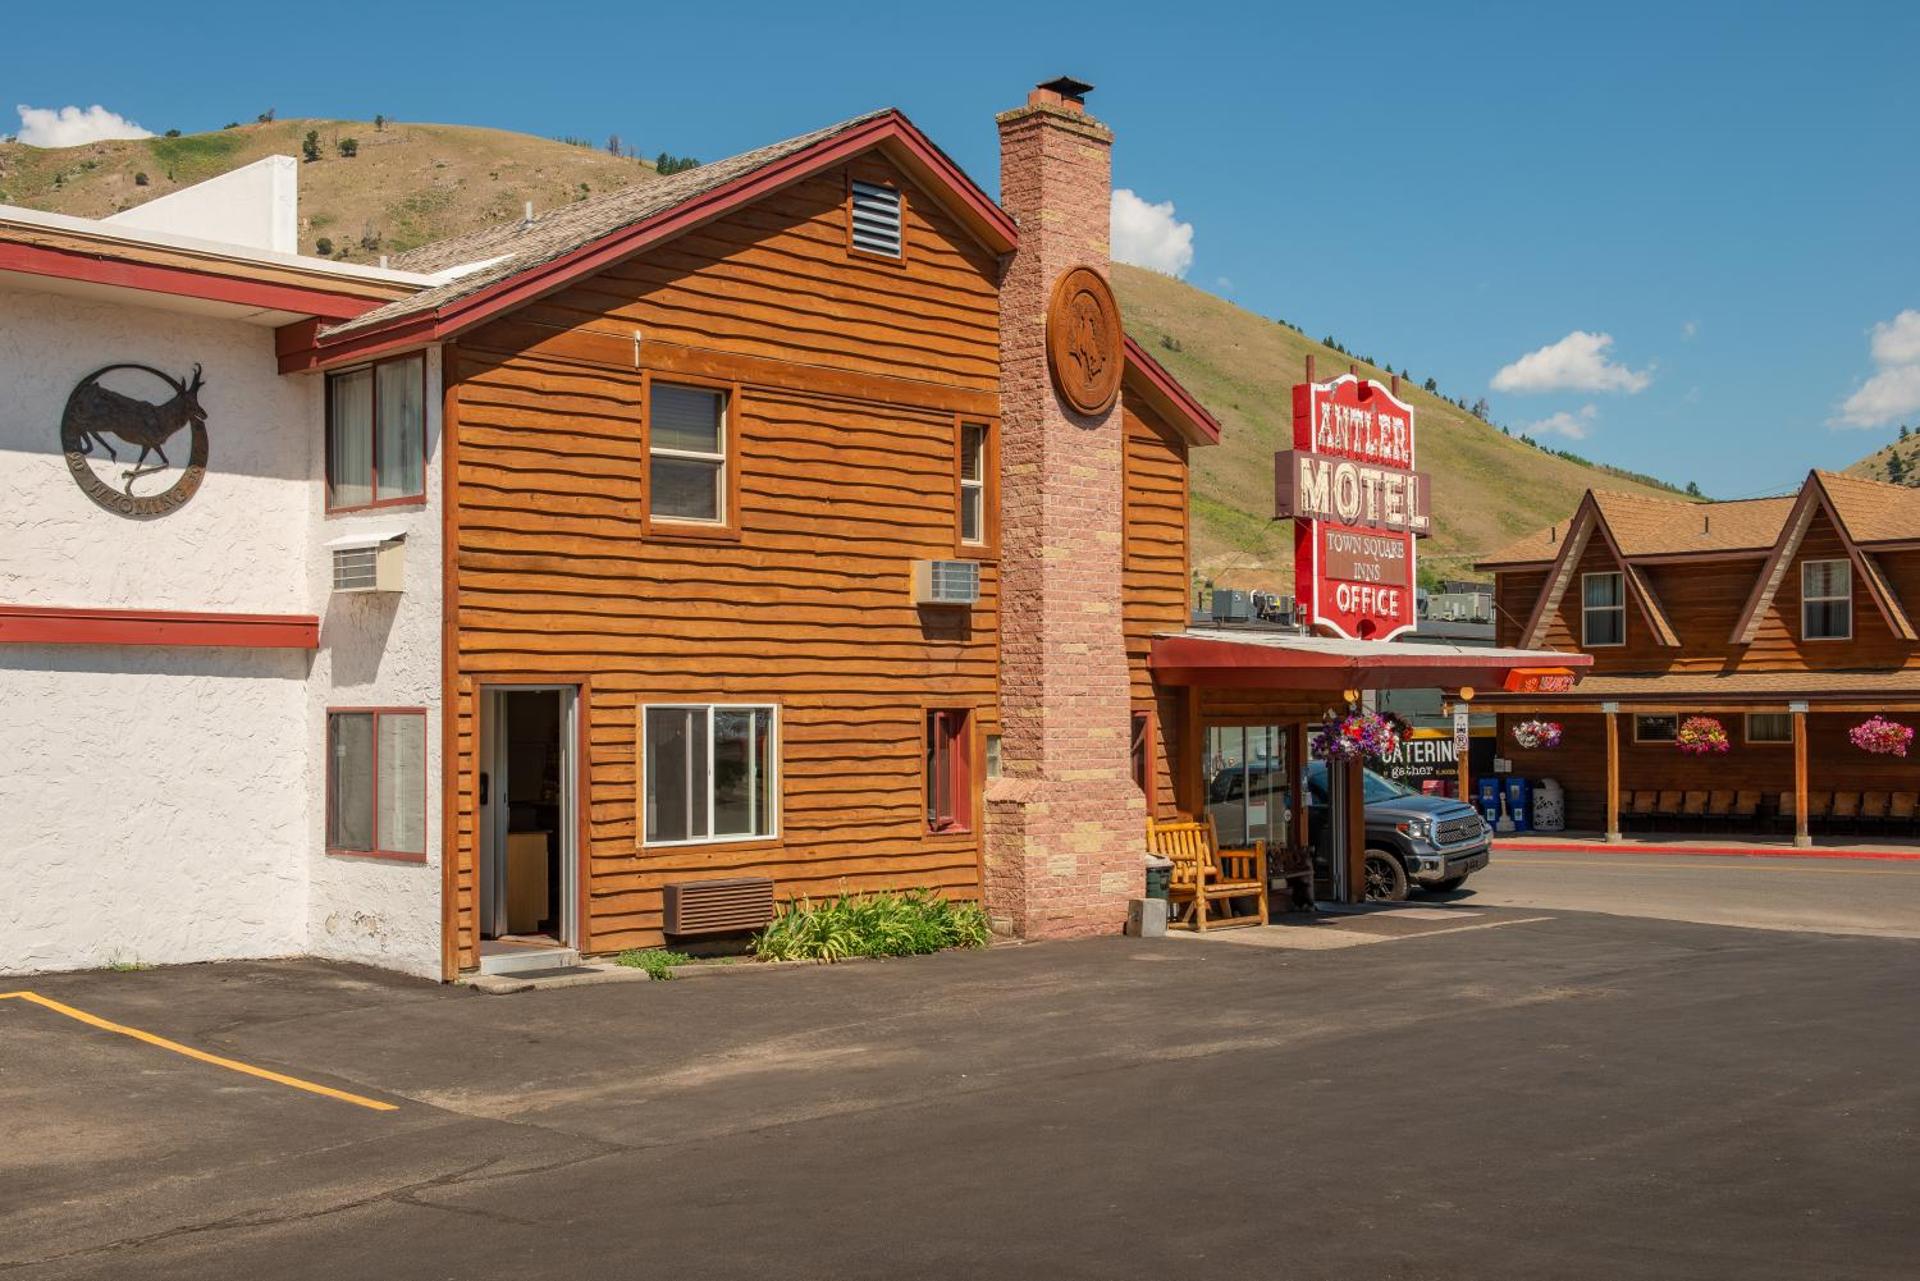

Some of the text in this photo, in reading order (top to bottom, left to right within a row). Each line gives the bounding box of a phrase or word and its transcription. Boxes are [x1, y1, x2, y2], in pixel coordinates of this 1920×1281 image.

[1317, 402, 1410, 462] ANTLER
[1300, 457, 1430, 529] MOTEL
[1327, 533, 1404, 562] TOWN SQUARE
[1353, 561, 1381, 582] INNS
[1336, 583, 1400, 618] OFFICE
[1391, 765, 1434, 779] gather
